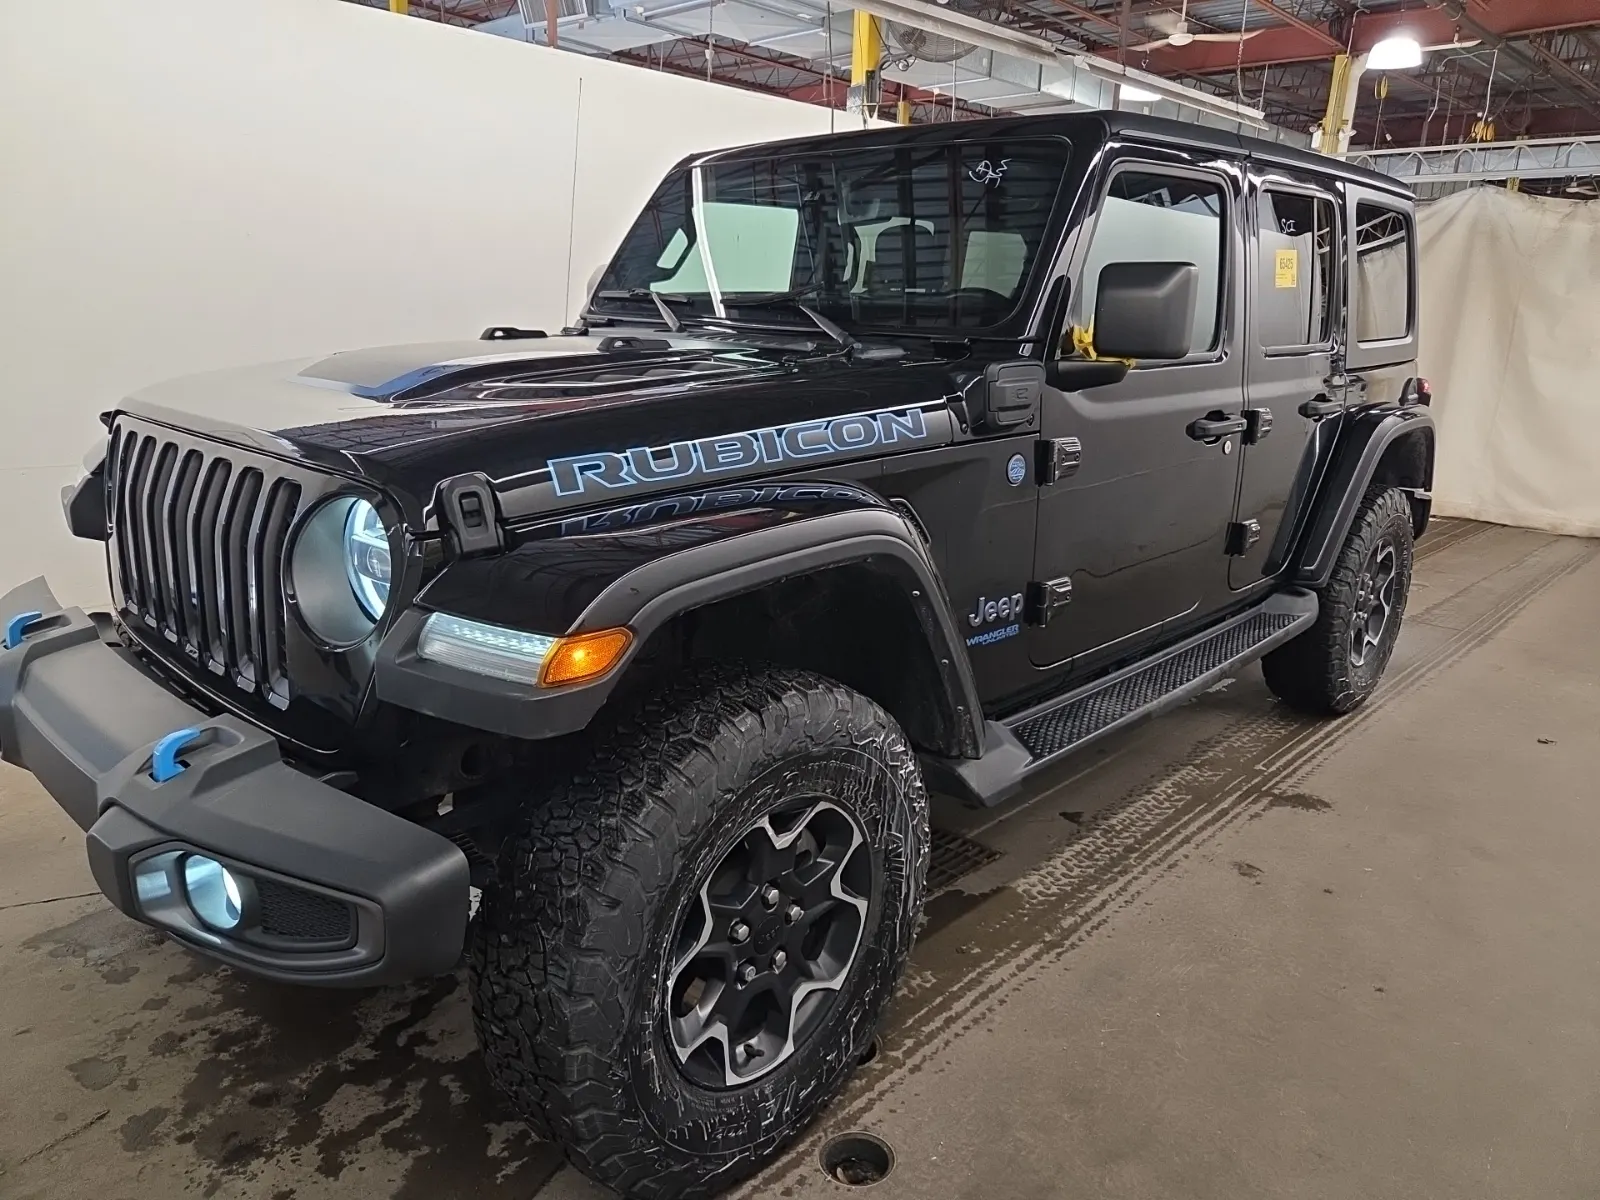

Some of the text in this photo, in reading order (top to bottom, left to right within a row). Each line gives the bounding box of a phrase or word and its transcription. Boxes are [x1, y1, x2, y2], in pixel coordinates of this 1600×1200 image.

[546, 407, 928, 497] RUBICON
[969, 593, 1023, 627] Jeep
[966, 624, 1019, 646] WRANGLER
